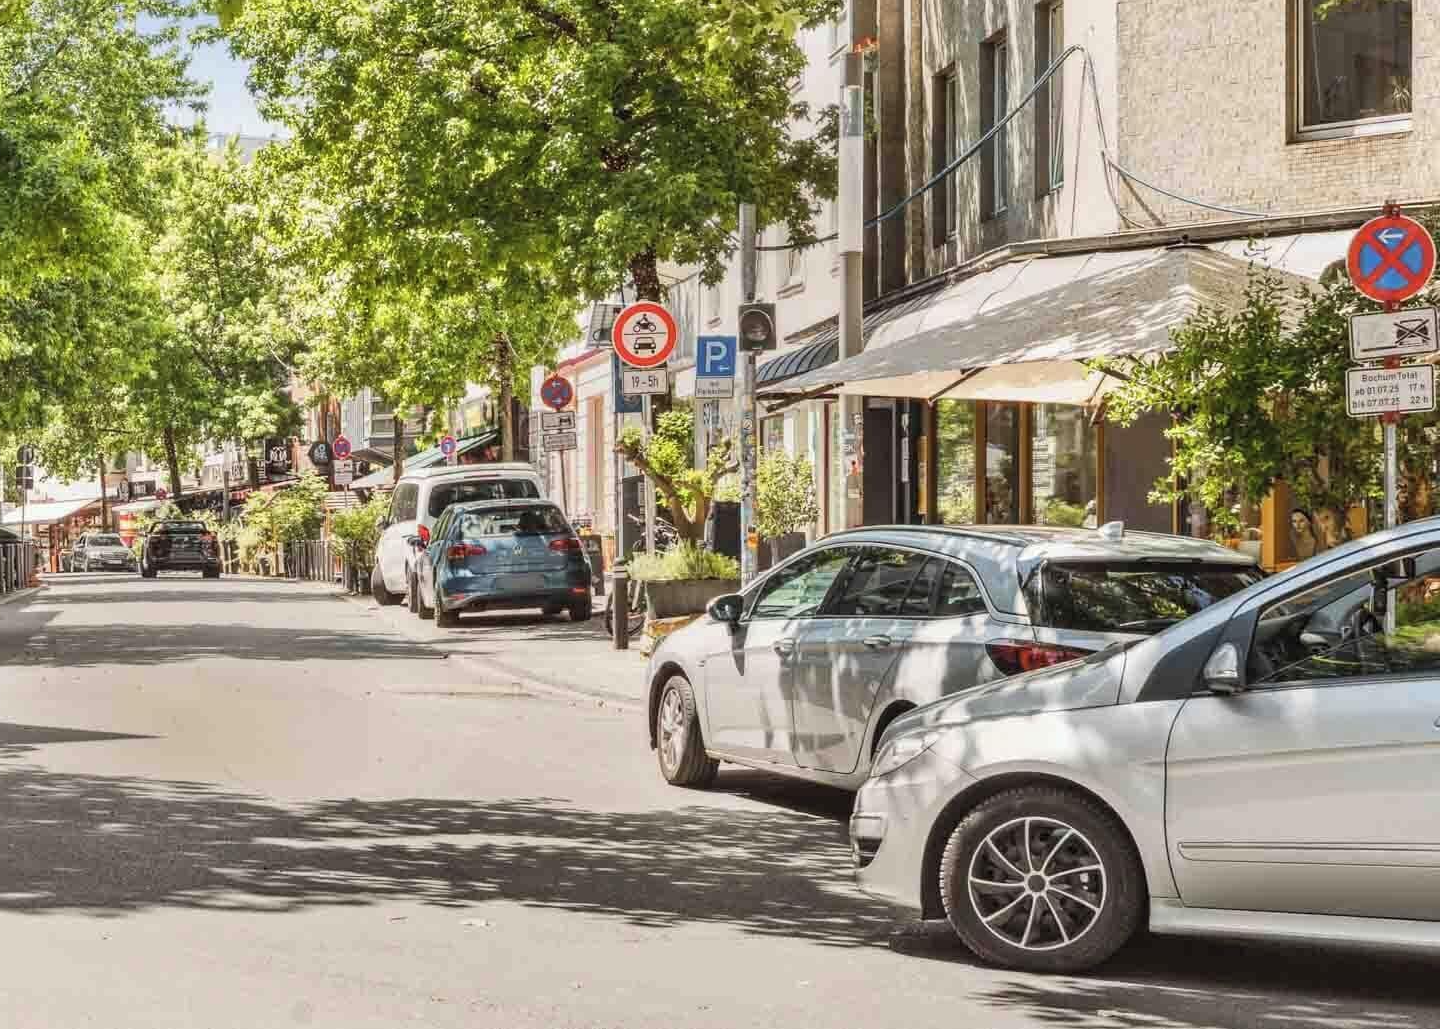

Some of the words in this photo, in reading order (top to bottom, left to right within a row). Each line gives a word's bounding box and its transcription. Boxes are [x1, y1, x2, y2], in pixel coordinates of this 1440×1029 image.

[705, 341, 727, 372] P
[631, 375, 640, 388] 19
[1361, 374, 1396, 382] Bochum
[1398, 372, 1418, 381] Total
[1410, 396, 1420, 404] 22
